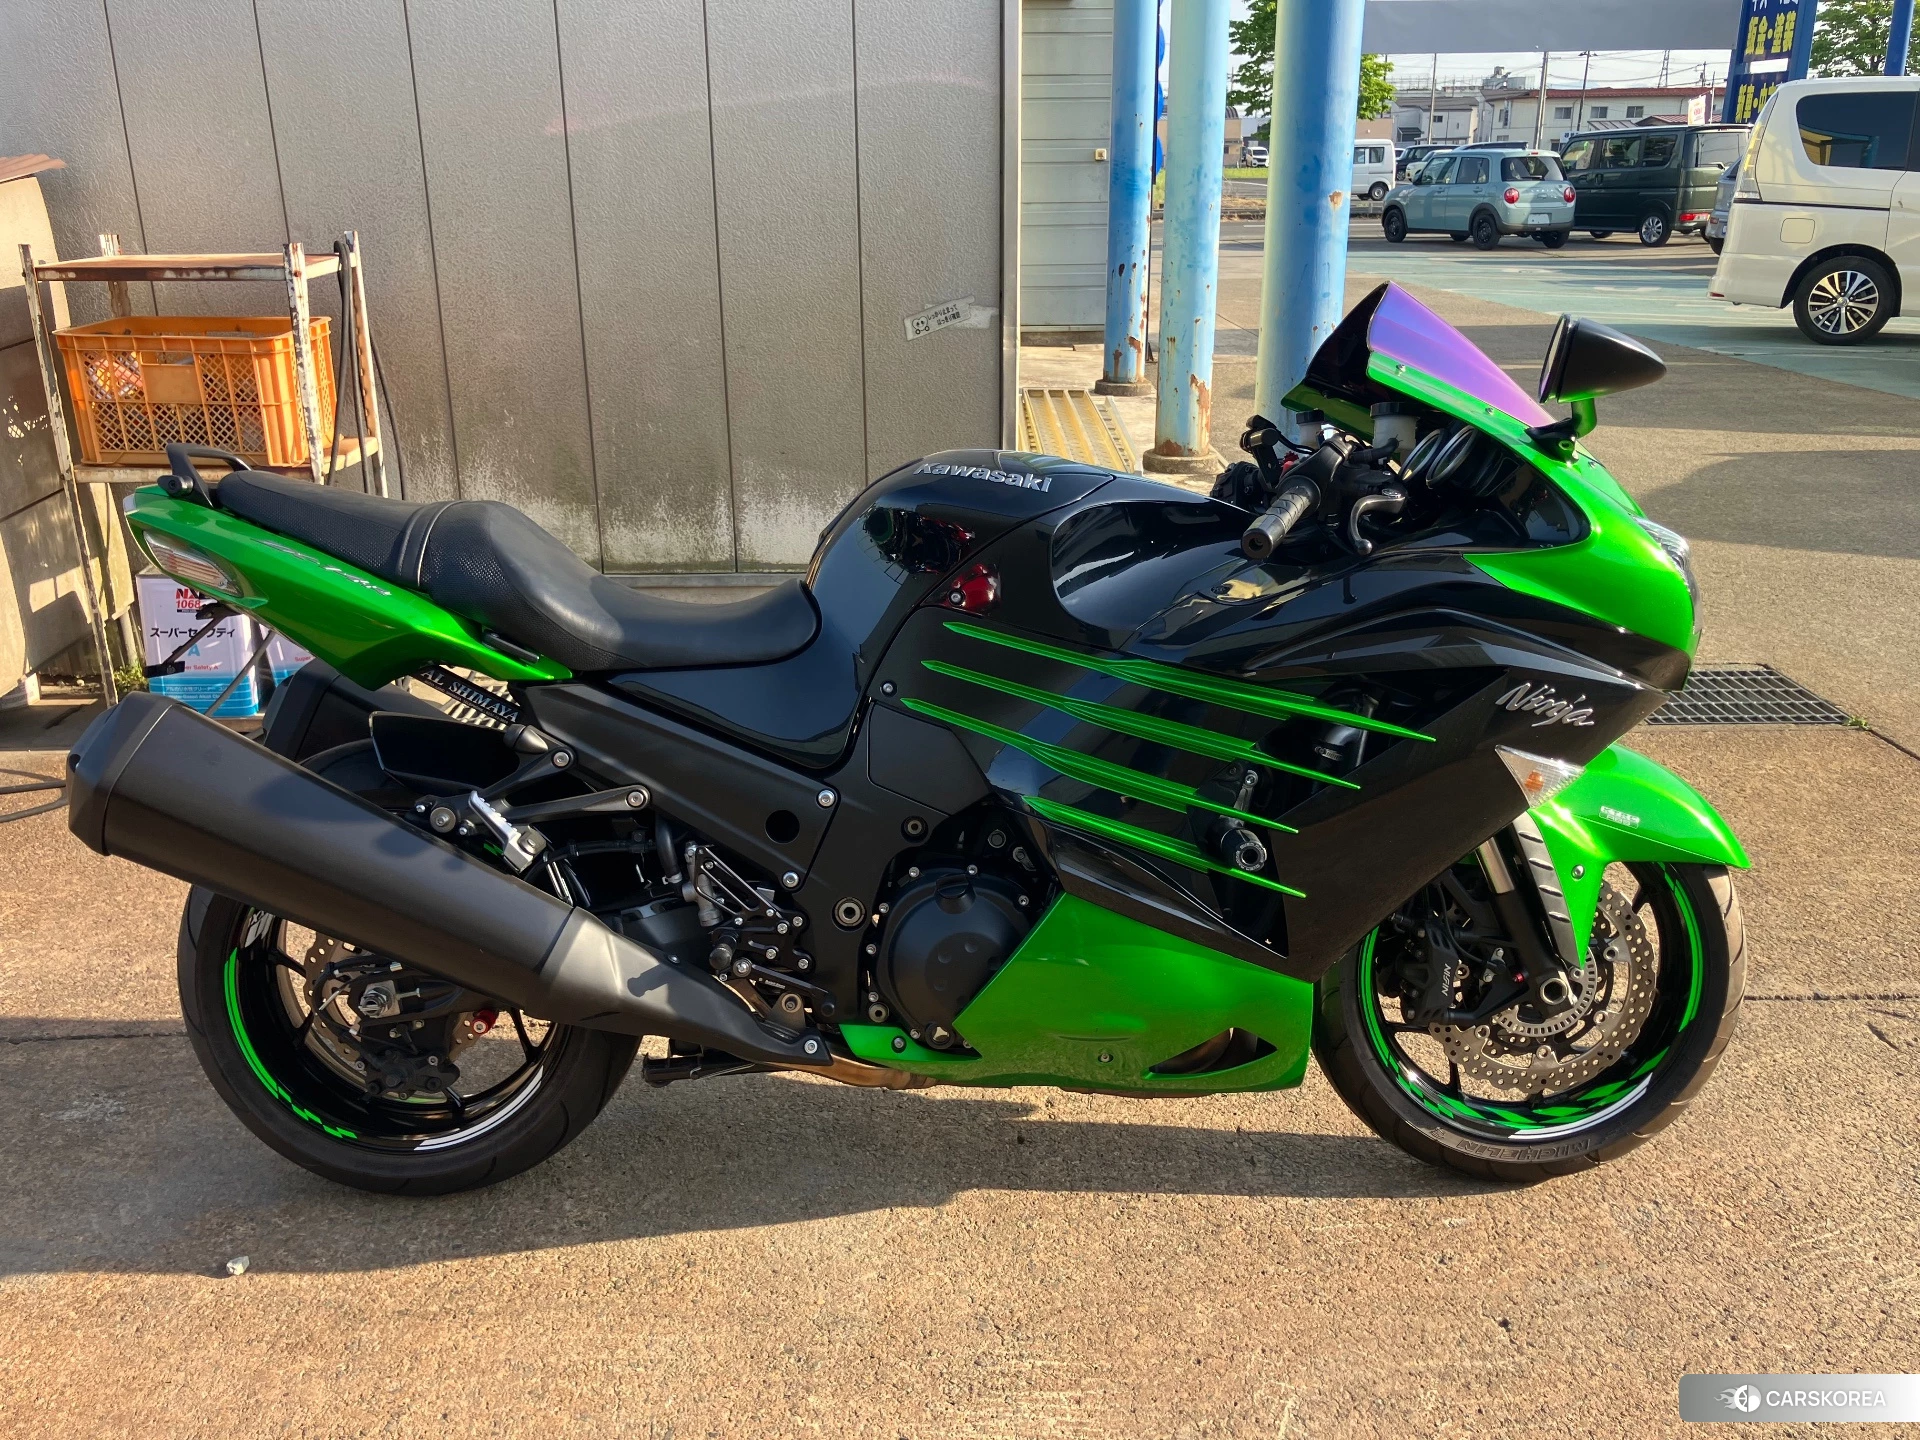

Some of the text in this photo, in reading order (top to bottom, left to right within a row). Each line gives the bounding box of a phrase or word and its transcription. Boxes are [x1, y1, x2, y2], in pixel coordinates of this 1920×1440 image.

[913, 462, 1052, 493] Kawasaki
[449, 681, 519, 723] SHIMAYA
[1495, 682, 1595, 727] Ninja
[1456, 1138, 1592, 1163] MICHELIN
